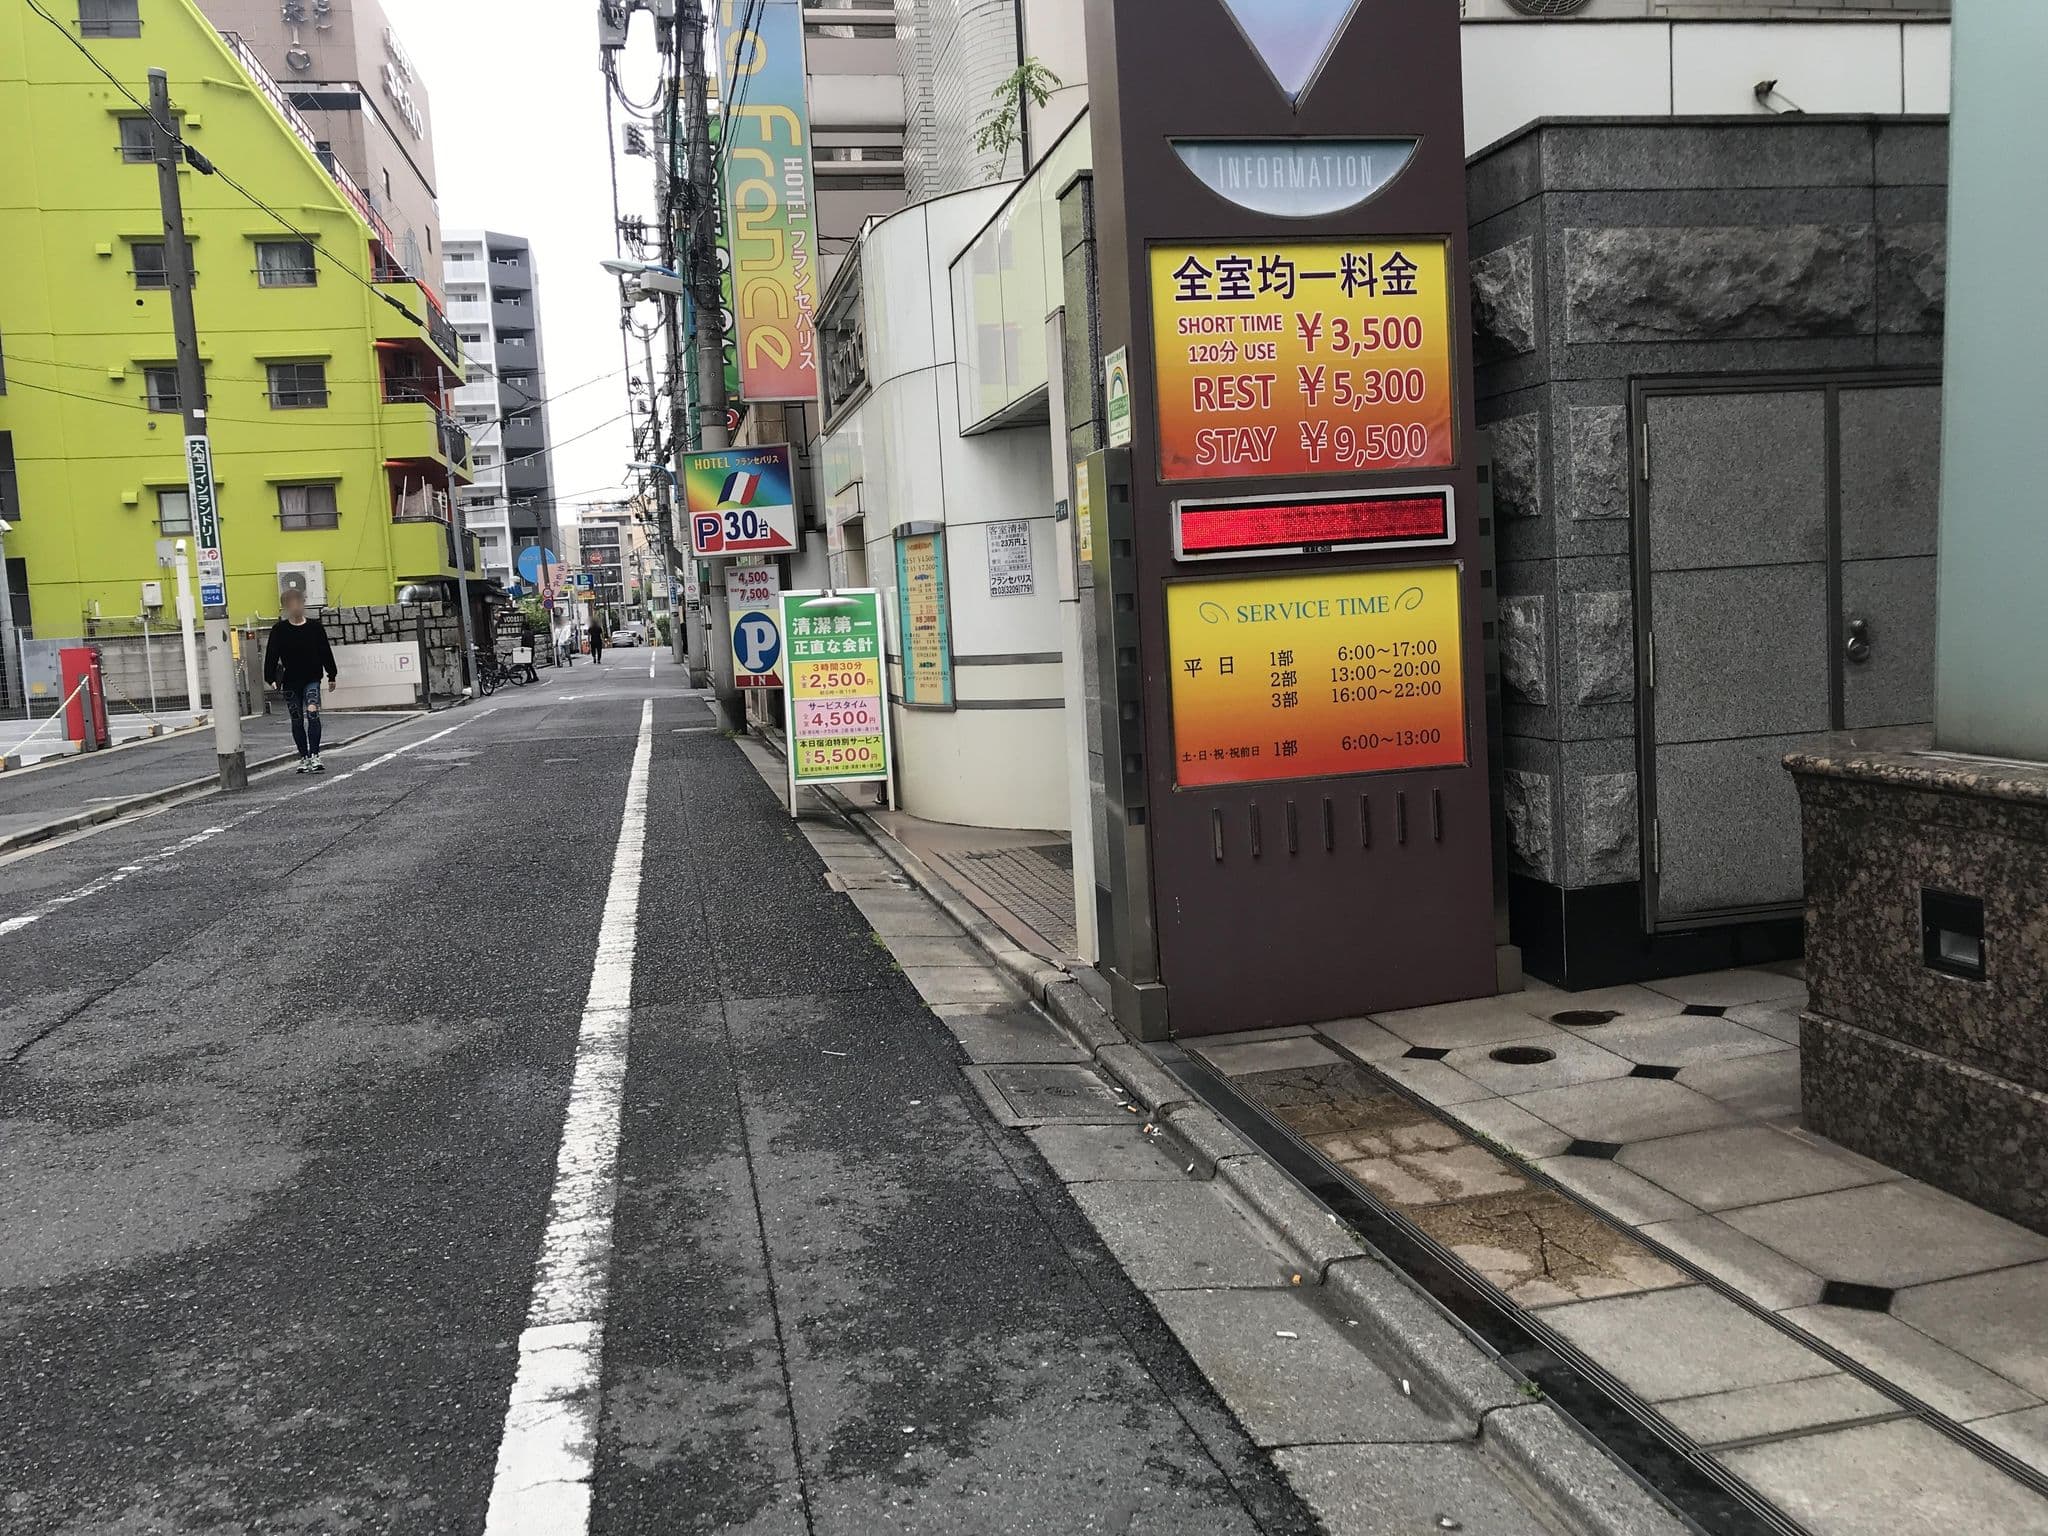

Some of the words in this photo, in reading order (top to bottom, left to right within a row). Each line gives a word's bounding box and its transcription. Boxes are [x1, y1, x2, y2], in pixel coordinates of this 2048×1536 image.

[1219, 155, 1373, 189] INFORMATION
[784, 157, 807, 225] HOTEL
[1172, 251, 1418, 302] 全室均一料金
[790, 231, 816, 370] フランセパリス
[1178, 315, 1236, 335] SHORT
[1240, 314, 1283, 332] TIME
[1188, 340, 1239, 364] 120分
[1244, 343, 1277, 361] USE
[1193, 373, 1276, 411] REST
[1196, 426, 1277, 465] STAY
[694, 457, 731, 470] HOTEL
[735, 456, 779, 466] フランセパリス
[1237, 599, 1329, 624] SERVICE
[1336, 595, 1390, 616] TIME
[741, 621, 776, 669] P
[794, 637, 873, 655] 正直な会計
[813, 662, 862, 671] 3時間30分
[1269, 649, 1294, 667] 1部
[750, 675, 766, 686] IN
[1270, 670, 1297, 688] 2部
[808, 700, 867, 711] サービスタイム
[1271, 690, 1298, 708] 3部
[1273, 739, 1298, 757] 1部
